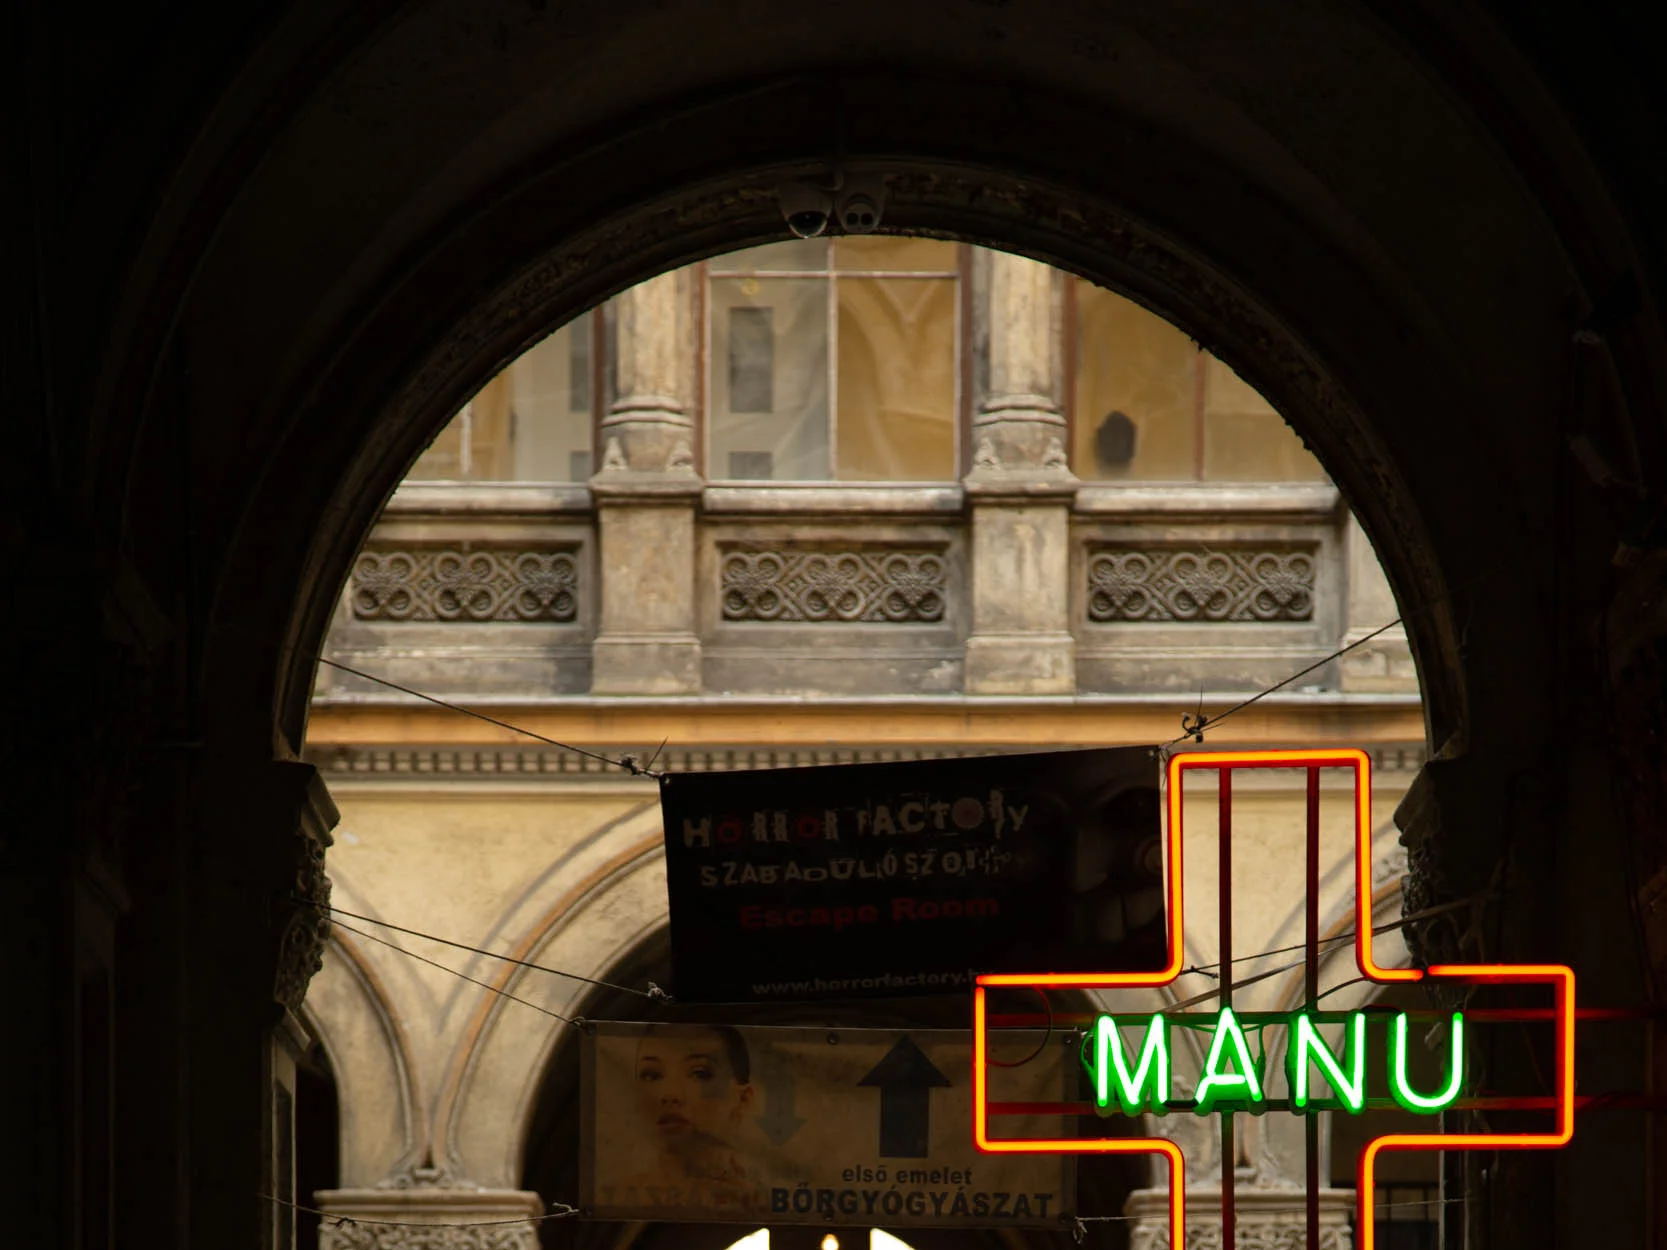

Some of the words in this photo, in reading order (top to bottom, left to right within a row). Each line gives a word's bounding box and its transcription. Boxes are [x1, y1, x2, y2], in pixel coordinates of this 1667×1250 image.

[739, 903, 880, 933] Escape
[891, 896, 999, 922] Room
[752, 967, 980, 996] www.horrorfactory.h
[1094, 1007, 1465, 1114] MANU
[895, 1166, 973, 1185] emelet
